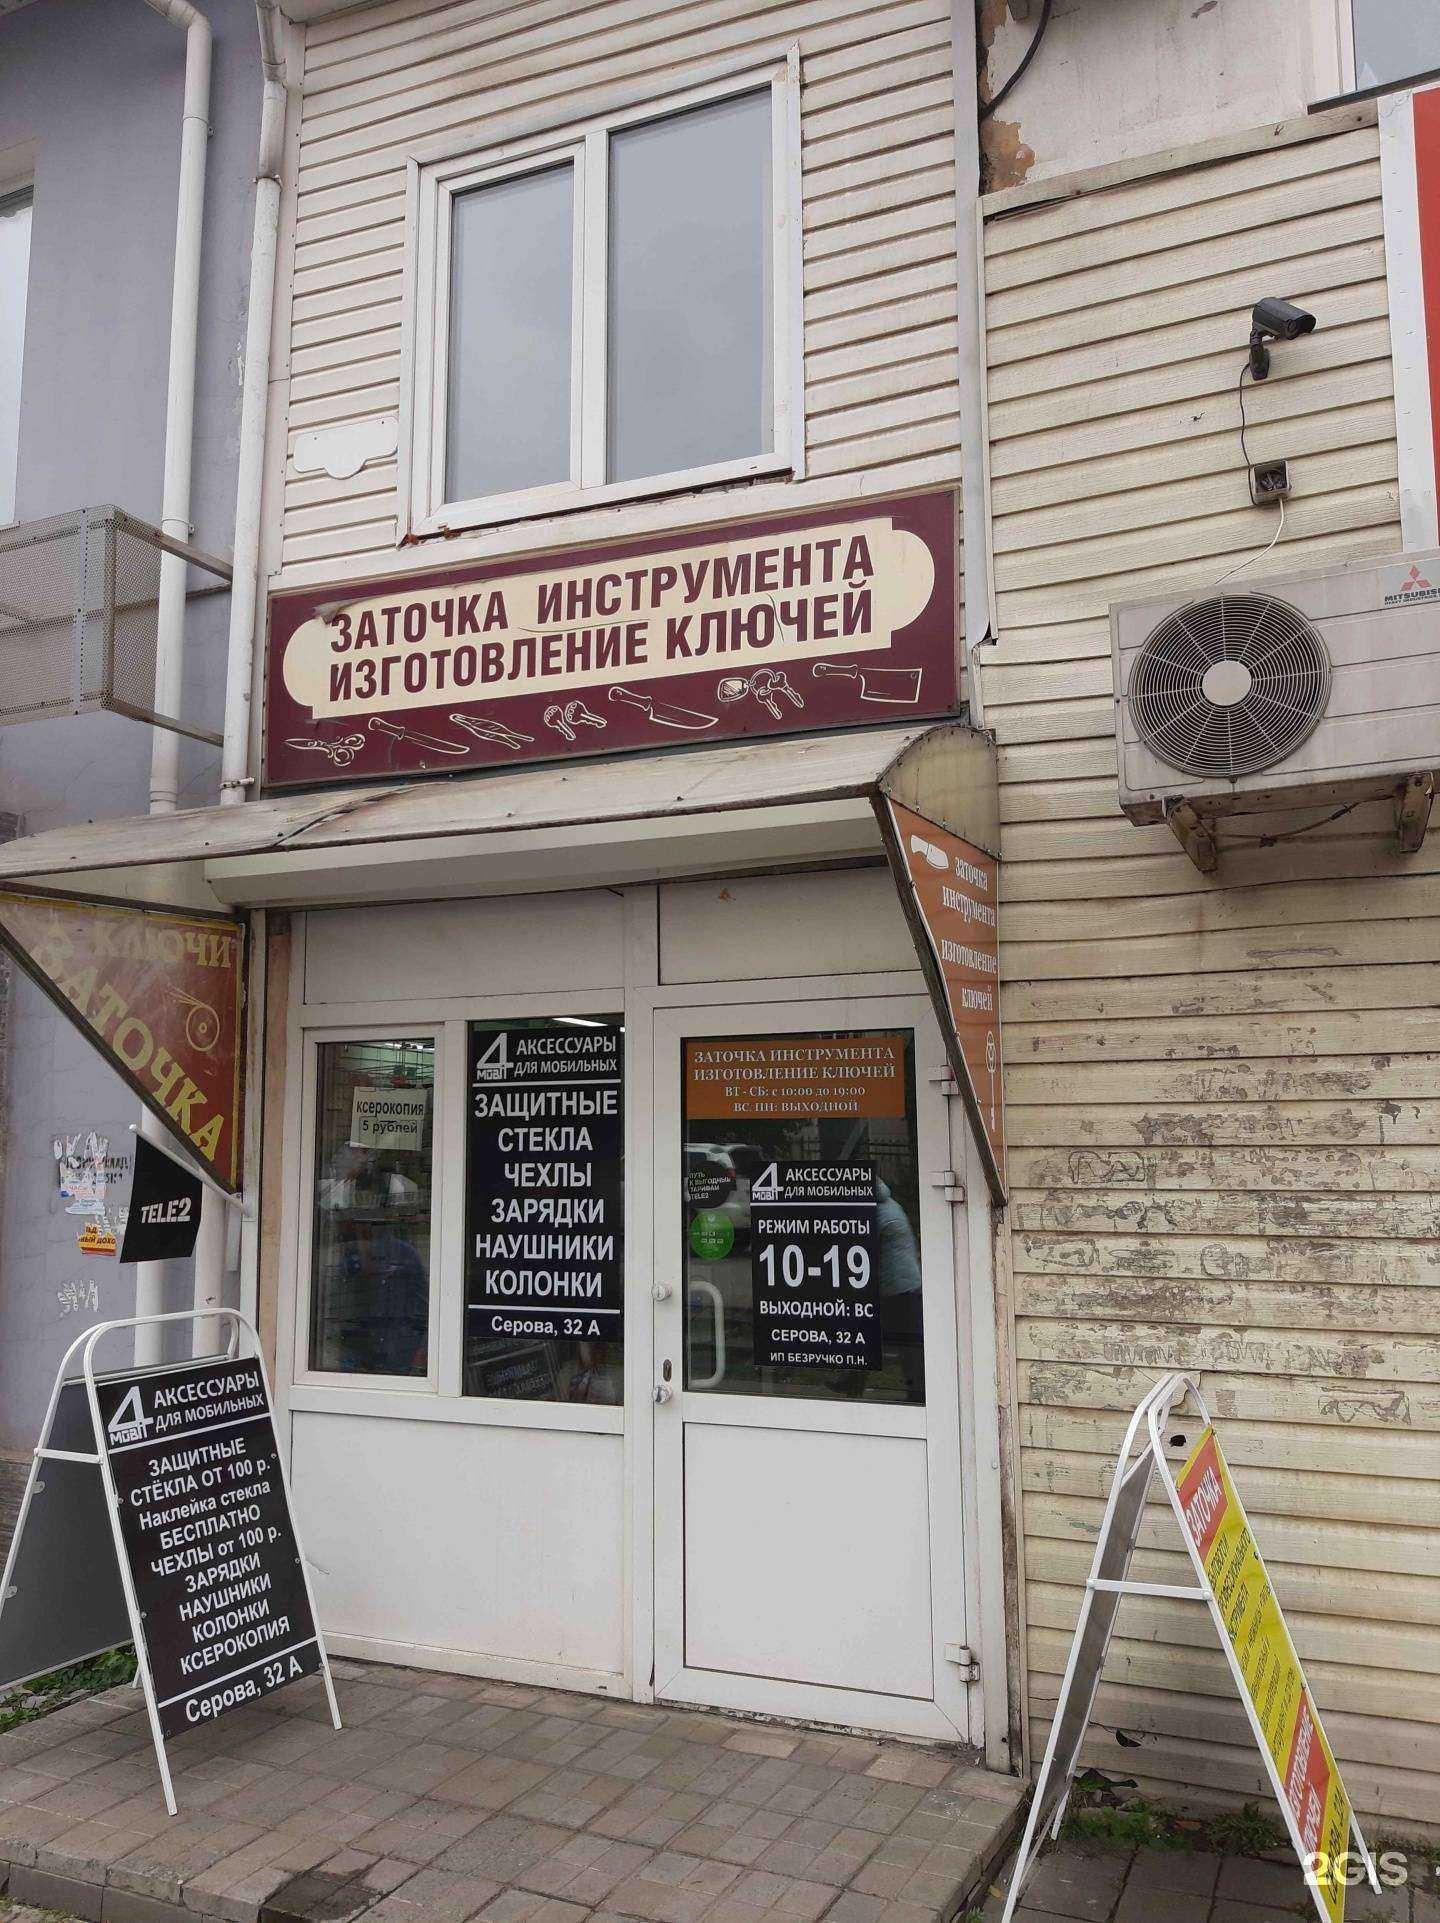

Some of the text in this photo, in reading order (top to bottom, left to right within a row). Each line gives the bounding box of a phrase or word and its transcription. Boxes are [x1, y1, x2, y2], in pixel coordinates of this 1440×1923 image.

[330, 534, 875, 653] ЗАТОЧКА ИНСТРУМЕНТА
[329, 581, 873, 704] ИЗГОТОВЛЕНИЕ КЛЮЧЕЙ
[93, 921, 232, 969] КЛЮЧИ
[516, 1036, 617, 1055] АКСЕССУАРЫ
[694, 1047, 896, 1063] ЗАТОЧКА ИНСТРУМЕНТА
[514, 1059, 617, 1077] ДЛЯ МОБИЛЬНЫХ
[694, 1063, 896, 1081] ИЗГОТОВЛЕНИЕ КЛЮЧЕЙ
[474, 1090, 618, 1121] ЗАЩИТНЫЕ
[725, 1087, 741, 1097] ВТ
[781, 1087, 814, 1097] 10:00
[781, 1099, 859, 1112] ВЫХОДНОЙ
[362, 1120, 418, 1134] 5 рублей
[498, 1127, 593, 1151] СТЕКЛА
[504, 1162, 592, 1187] ЧЕХЛЫ
[786, 1168, 872, 1182] АКСЕССУАРЫ
[784, 1186, 873, 1198] ДЛЯ МОБИЛЬНЫХ
[141, 1197, 191, 1224] TELE2
[491, 1198, 604, 1228] ЗАРЯДКИ
[758, 1220, 870, 1235] РЕЖИМ РАБОТЫ
[475, 1234, 613, 1261] НАУШНИКИ
[759, 1244, 871, 1289] 10-19
[485, 1269, 602, 1298] КОЛОНКИ
[760, 1299, 874, 1318] ВЫХОДНОЙ: ВС
[491, 1315, 601, 1337] Серова, 32 А
[771, 1329, 866, 1345] СЕРОВА, 32 А
[770, 1352, 868, 1366] ИП БЕЗРУЧКО П.Н.
[154, 1371, 260, 1409] АКСЕССУАРЫ
[155, 1393, 264, 1433] ДЛЯ МОБИЛЬНЫХ
[148, 1437, 246, 1477] ЗАЩИТНЫЕ
[130, 1459, 271, 1507] СТЁКЛА ОТ 100 р.
[139, 1480, 271, 1531] Наклейка стекла
[1186, 1466, 1222, 1547] ЗАТОЧКА
[159, 1504, 261, 1550] БЕСПЛАТНО
[151, 1526, 282, 1577] ЧЕХЛЫ от 100 р.
[184, 1552, 261, 1594] ЗАРЯДКИ
[178, 1572, 272, 1622] НАУШНИКИ
[192, 1598, 270, 1644] КОЛОНКИ
[179, 1615, 291, 1676] КСЕРОКОПИЯ
[185, 1654, 304, 1723] Серова, 32 А
